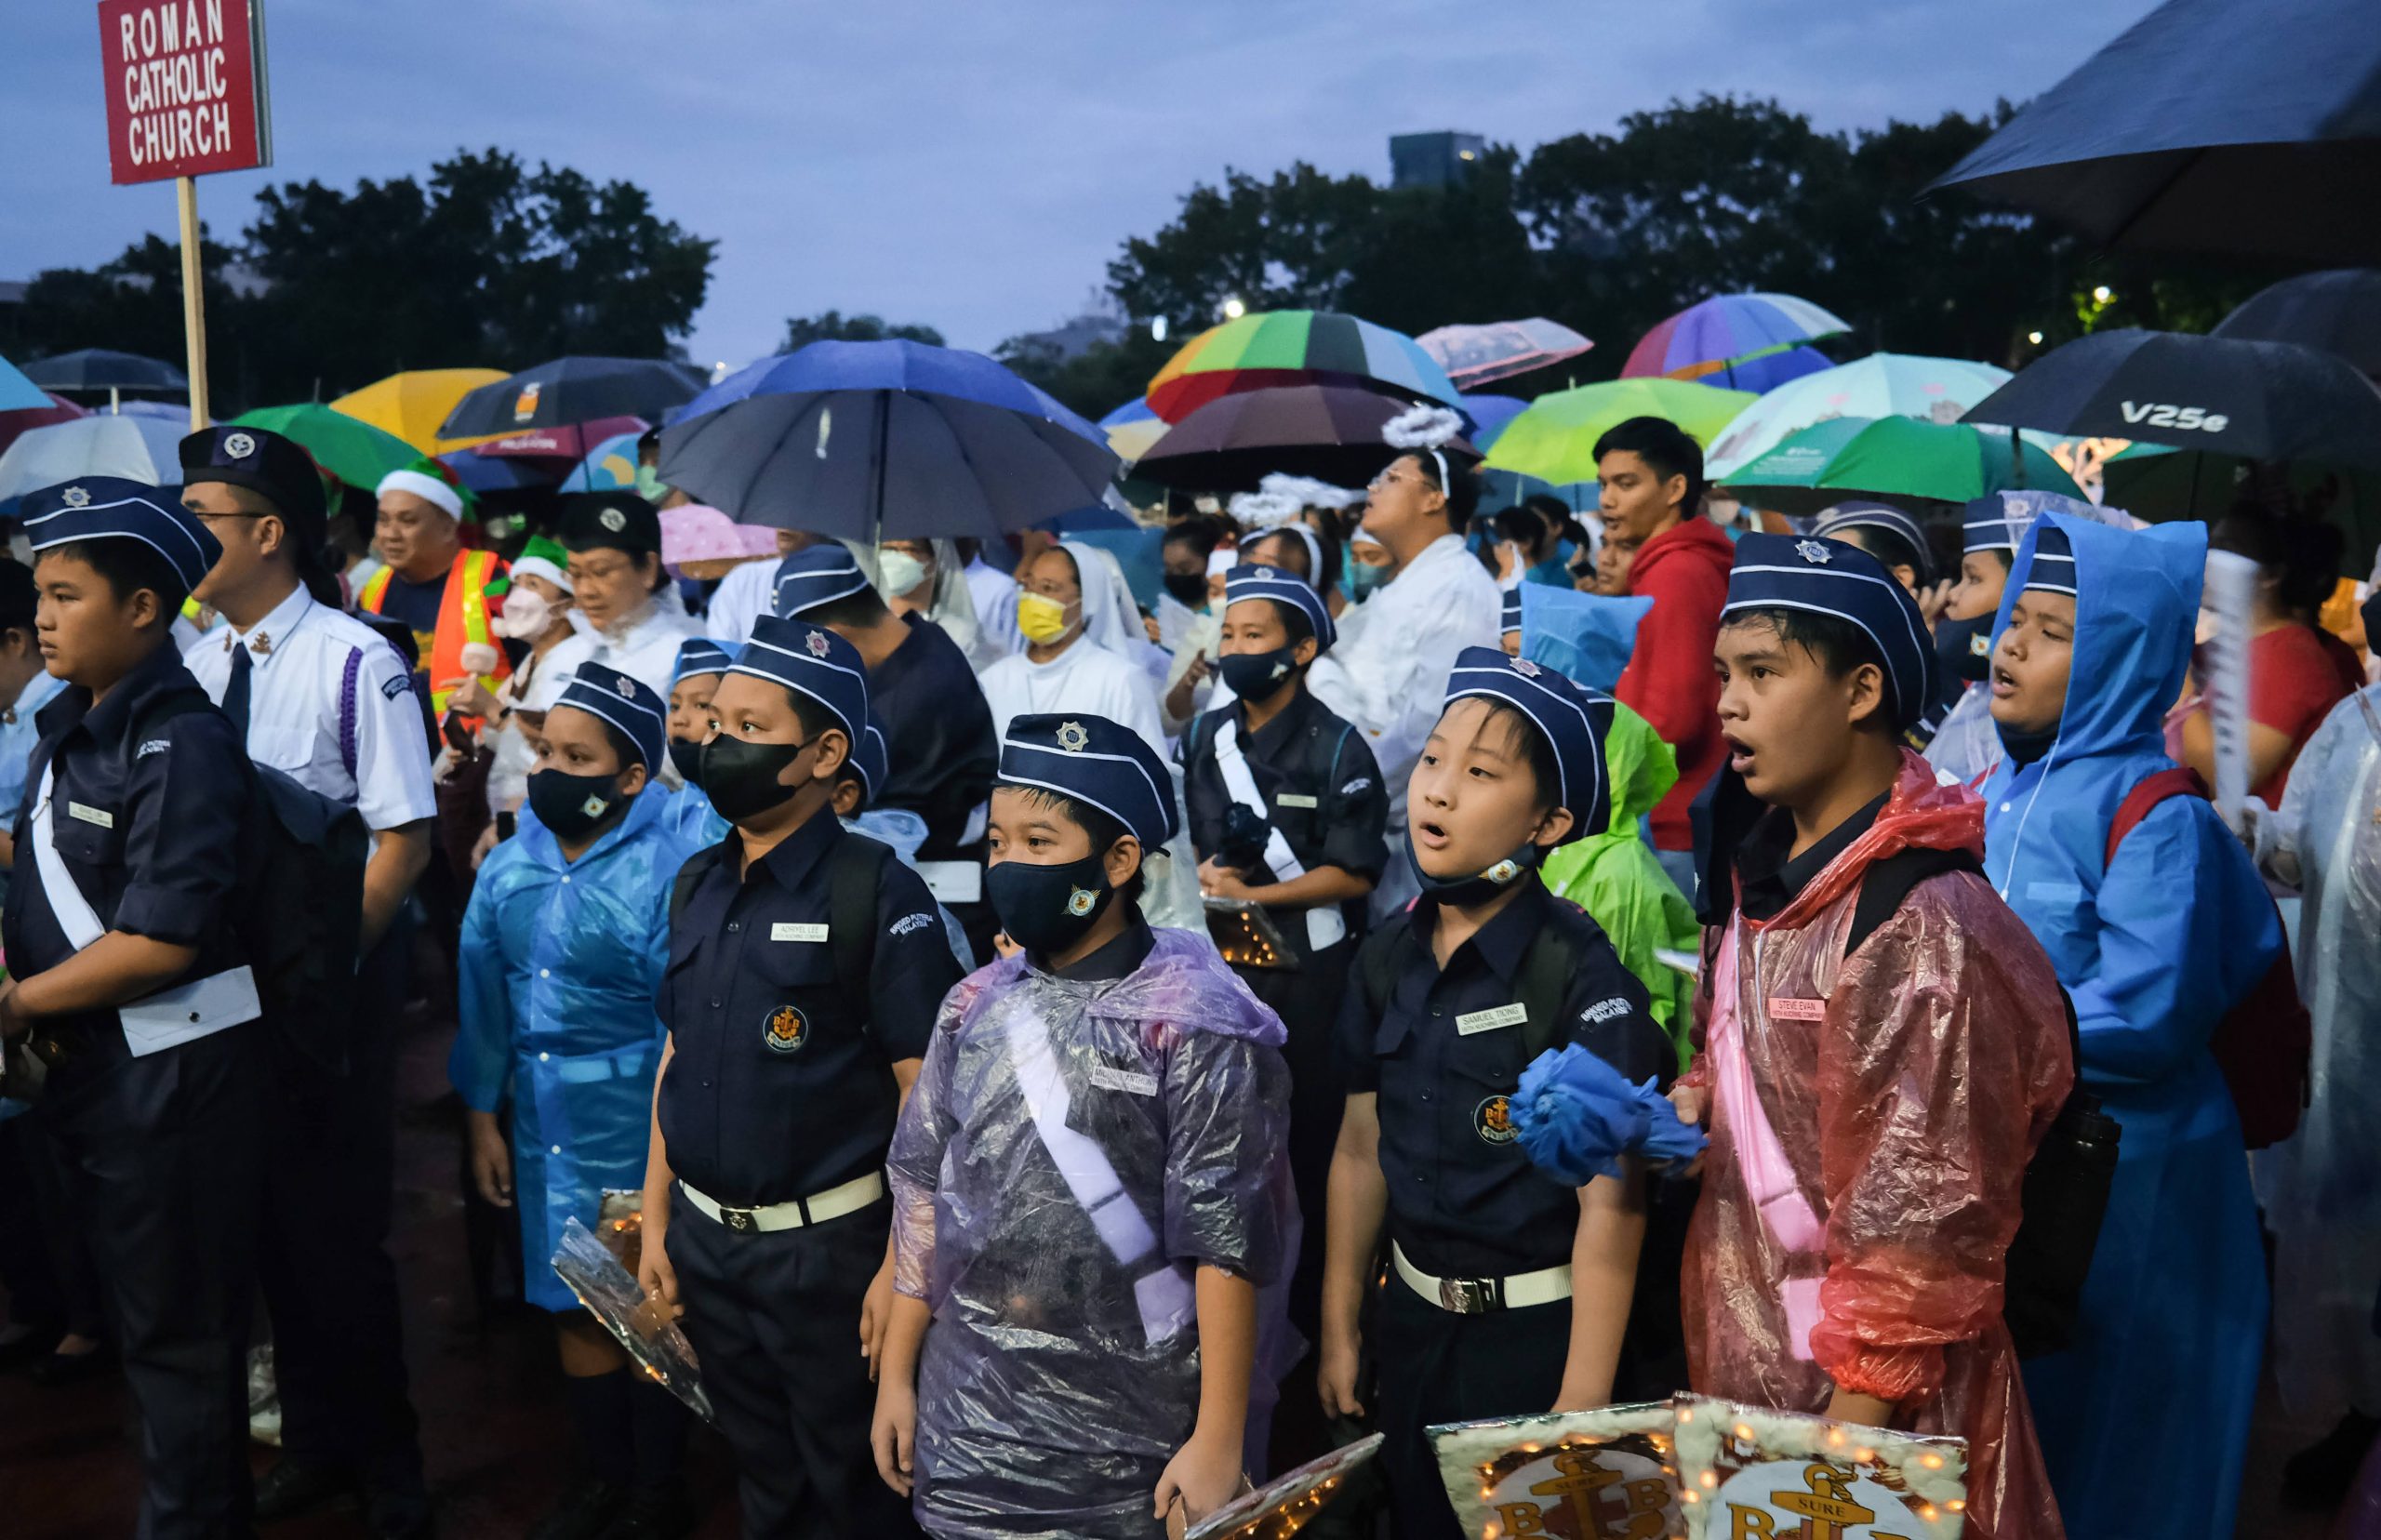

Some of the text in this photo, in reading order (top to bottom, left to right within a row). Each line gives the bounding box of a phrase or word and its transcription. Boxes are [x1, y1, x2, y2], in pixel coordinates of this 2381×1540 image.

[120, 0, 223, 62] ROMAN
[125, 47, 227, 113] CATHOLIC
[128, 101, 231, 166] CHURCH
[1462, 1005, 1520, 1026] SAMUEL TIONG
[1777, 1000, 1816, 1011] STEVE EVAN
[1494, 1478, 1671, 1536] B B
[1798, 1497, 1846, 1518] SURE
